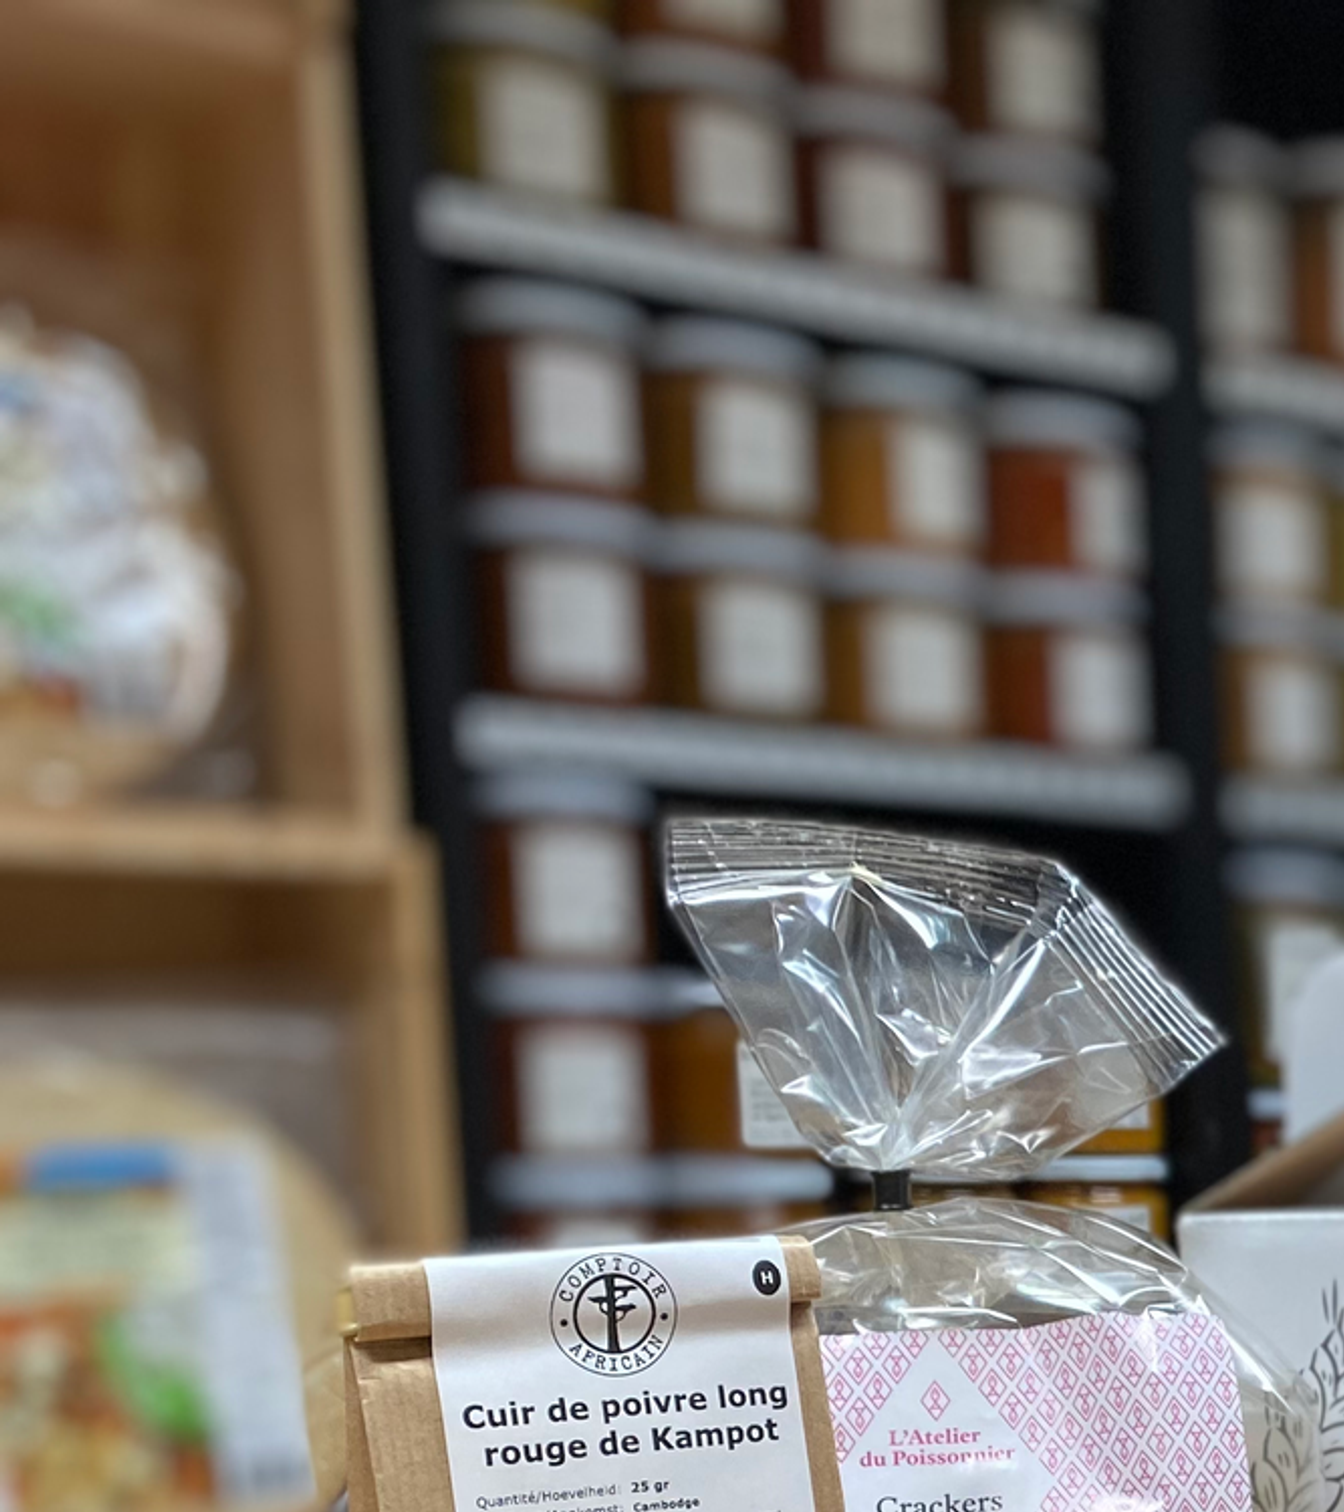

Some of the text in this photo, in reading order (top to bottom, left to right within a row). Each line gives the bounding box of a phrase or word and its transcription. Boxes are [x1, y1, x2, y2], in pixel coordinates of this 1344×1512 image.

[559, 1257, 668, 1303] COMPTOIR
[569, 1334, 664, 1371] AFRICAIN
[462, 1384, 788, 1429] Cuir de poivre long
[485, 1418, 779, 1466] rouge de Kampot
[889, 1428, 981, 1446] L'Atelier
[860, 1446, 1015, 1467] du Poissonnier
[631, 1481, 649, 1493] 25
[654, 1480, 670, 1493] gr
[633, 1499, 700, 1512] Cambodge
